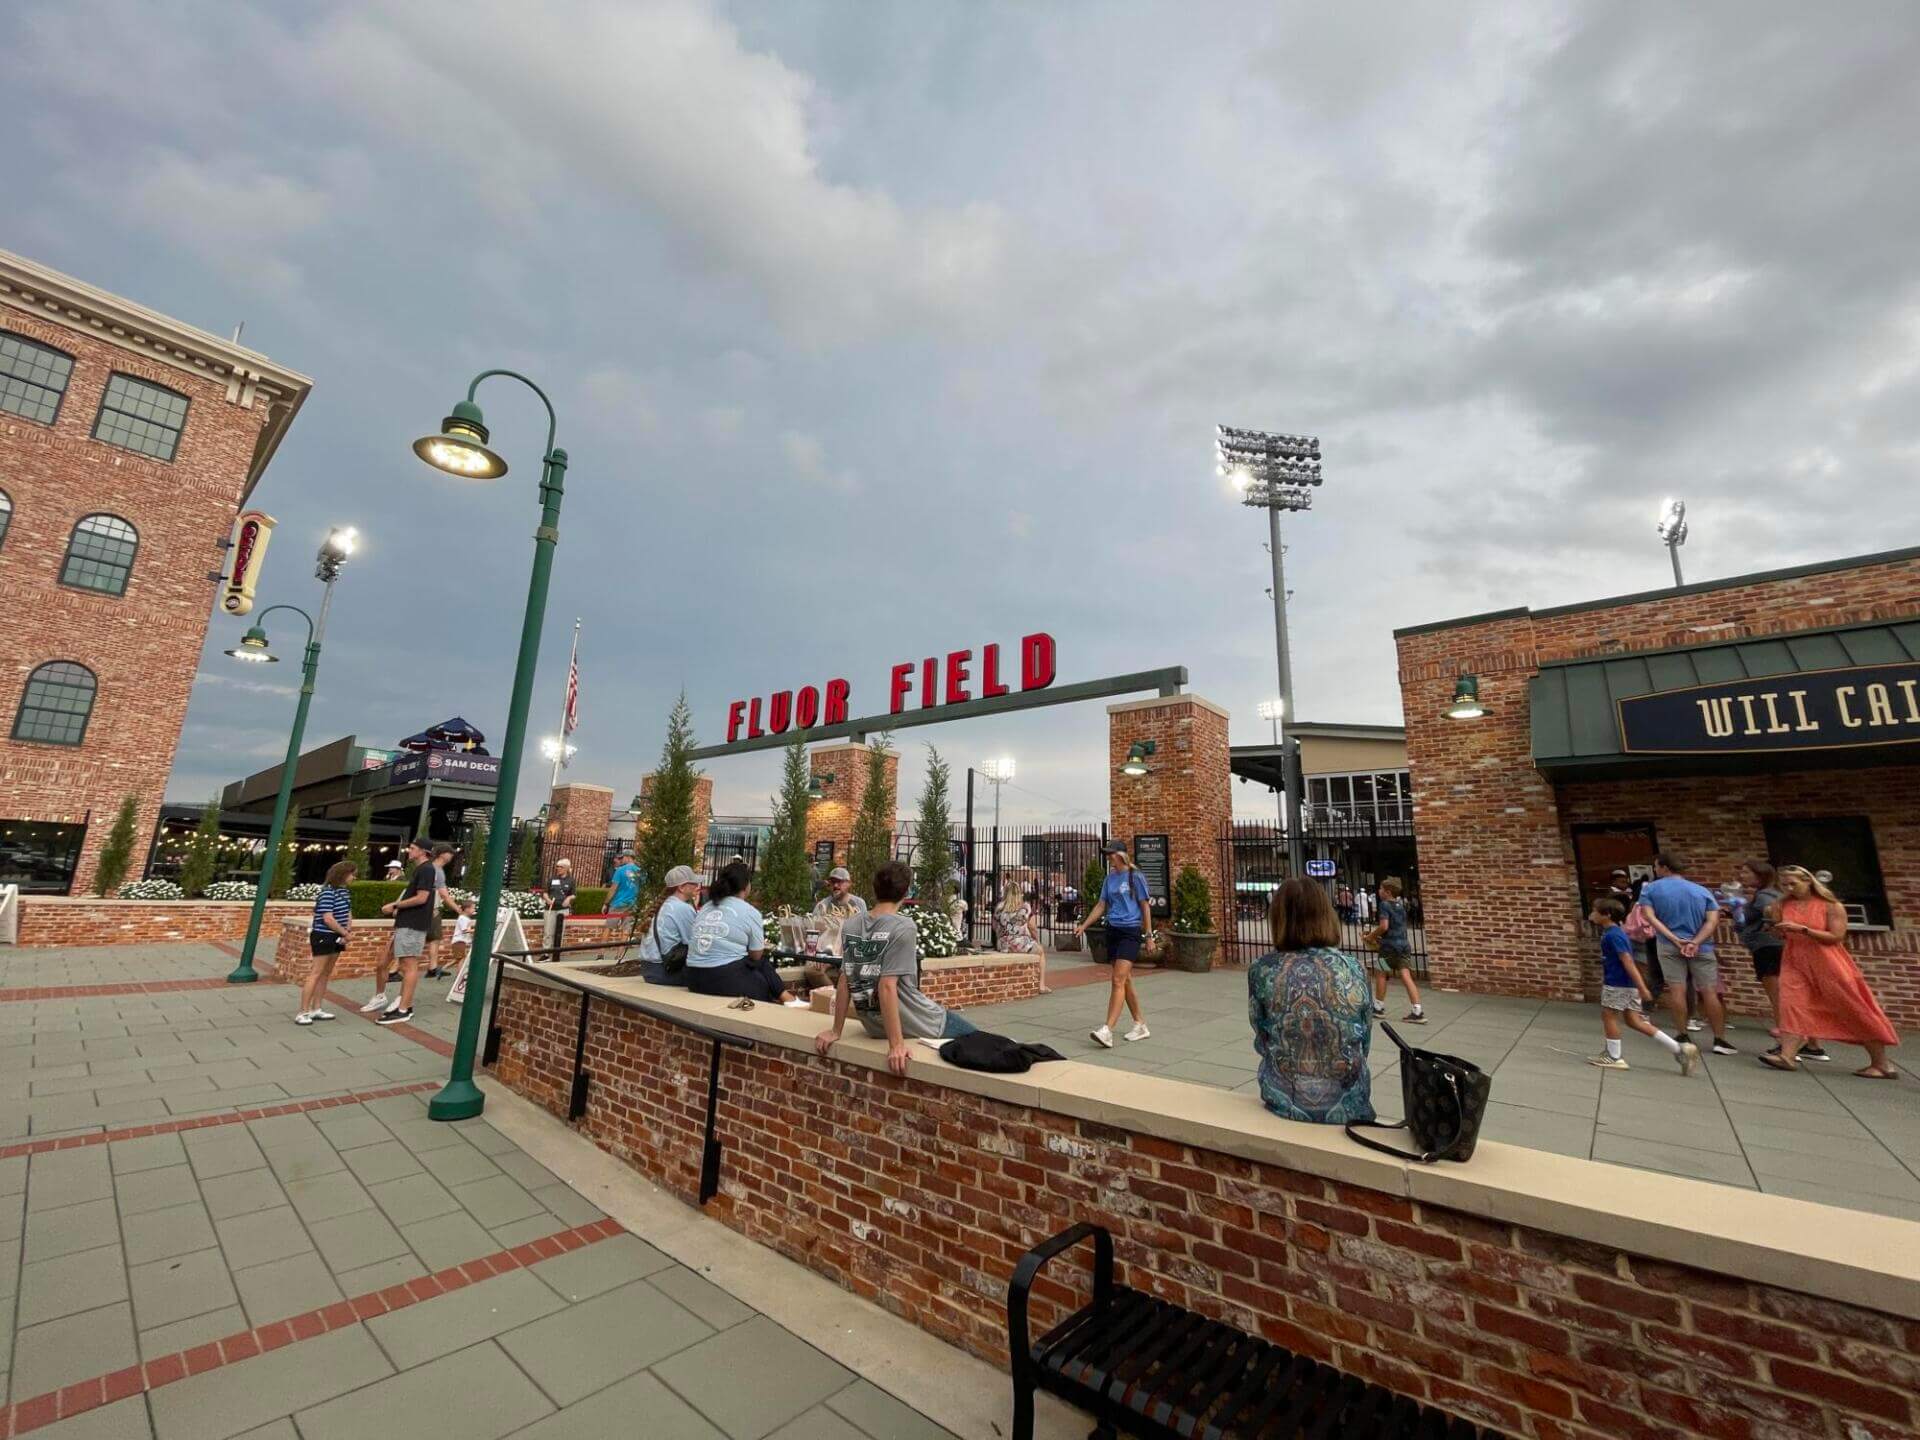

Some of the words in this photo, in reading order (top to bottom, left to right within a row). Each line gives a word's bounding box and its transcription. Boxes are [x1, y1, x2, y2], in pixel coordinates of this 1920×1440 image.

[727, 678, 850, 743] FLUOR
[890, 632, 1057, 714] FIELD
[1696, 690, 1819, 737] WILL
[444, 758, 468, 769] SAM
[469, 761, 497, 773] DECK
